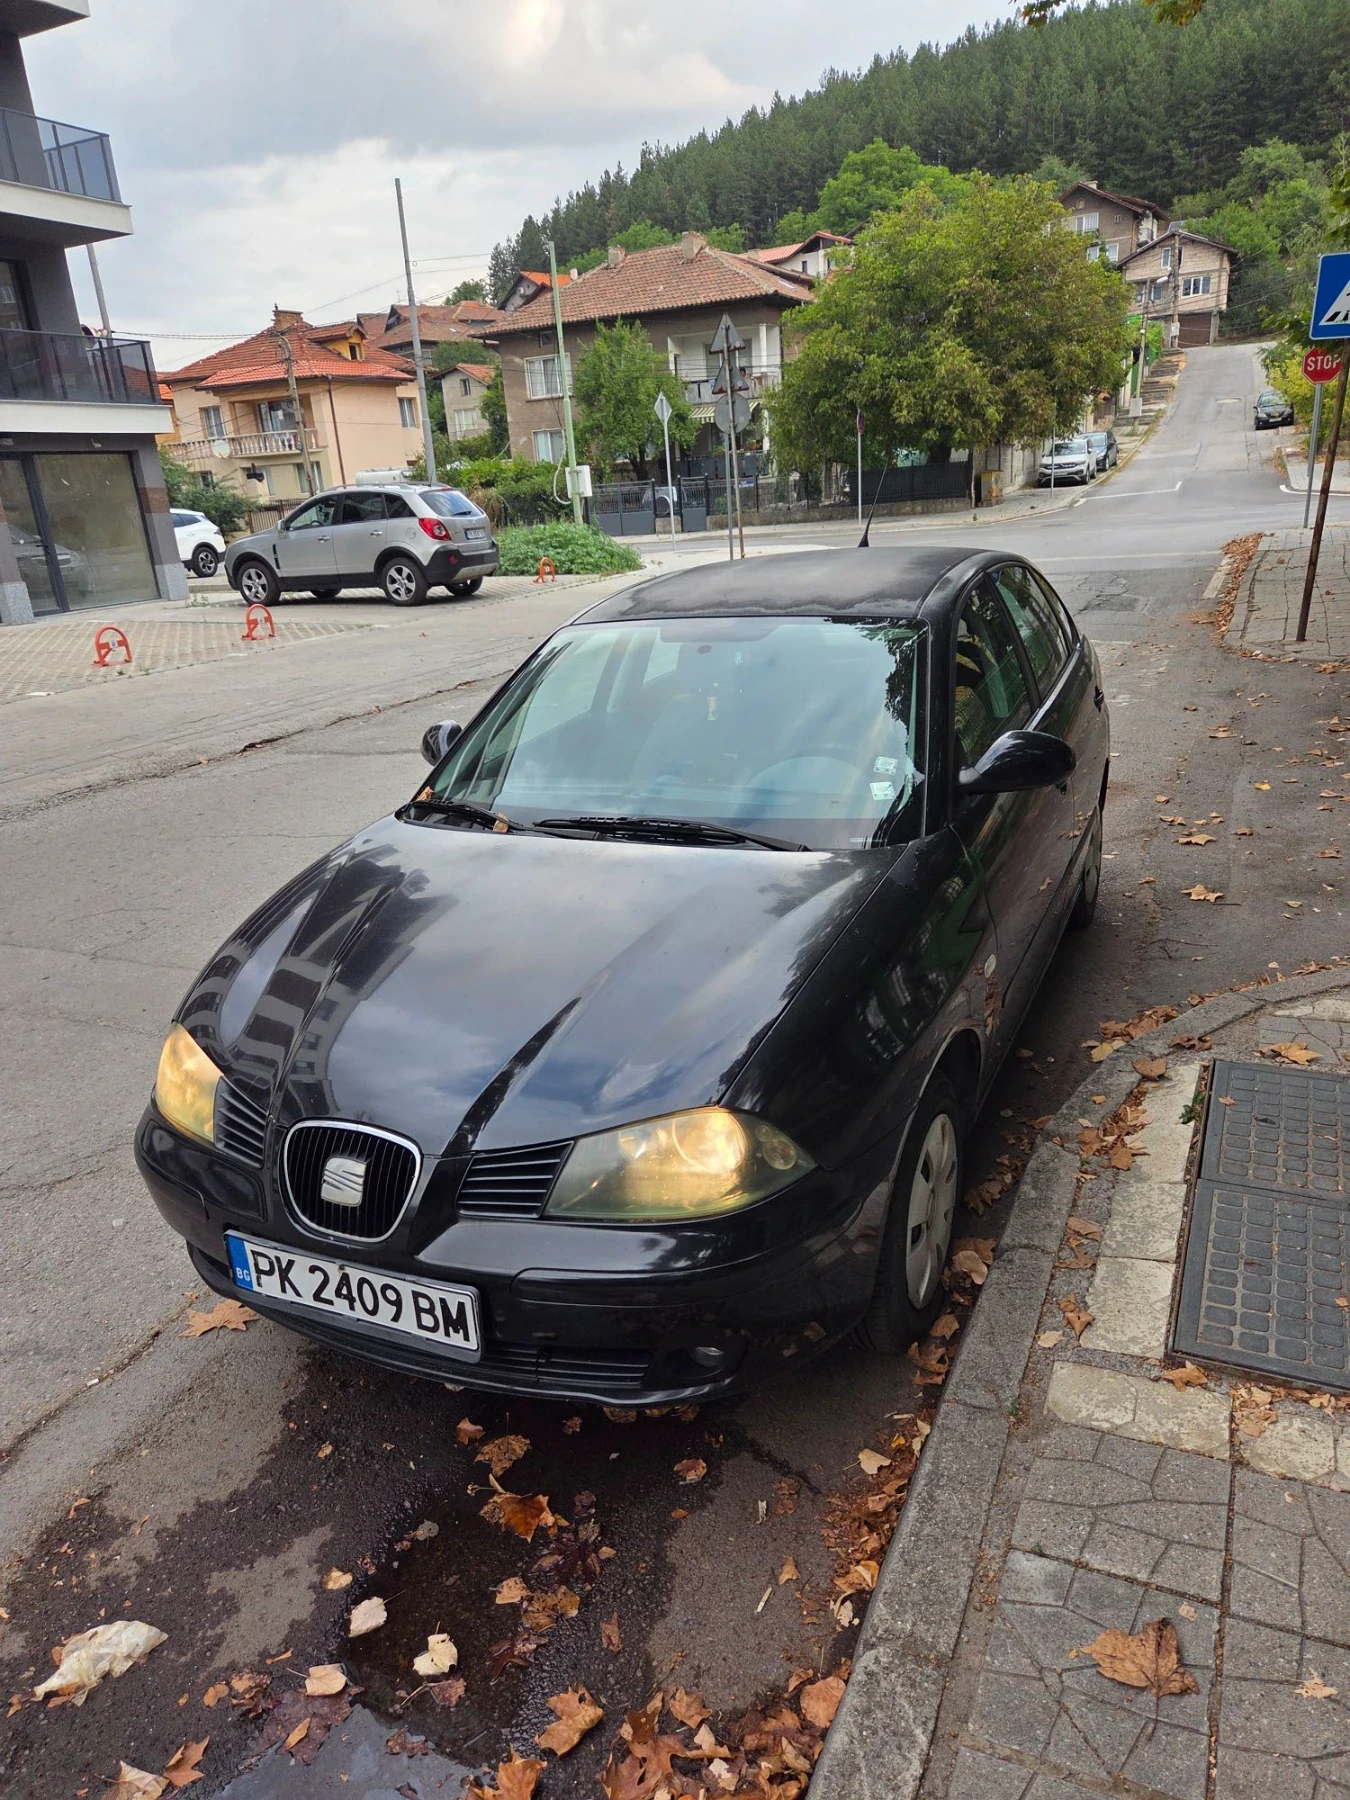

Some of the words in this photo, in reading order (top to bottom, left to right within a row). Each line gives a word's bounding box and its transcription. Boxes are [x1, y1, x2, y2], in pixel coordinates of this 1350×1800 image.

[1307, 355, 1341, 371] STOP
[235, 1267, 251, 1281] BG
[250, 1249, 303, 1298] PK
[308, 1264, 403, 1323] 2409
[411, 1290, 471, 1342] BM
